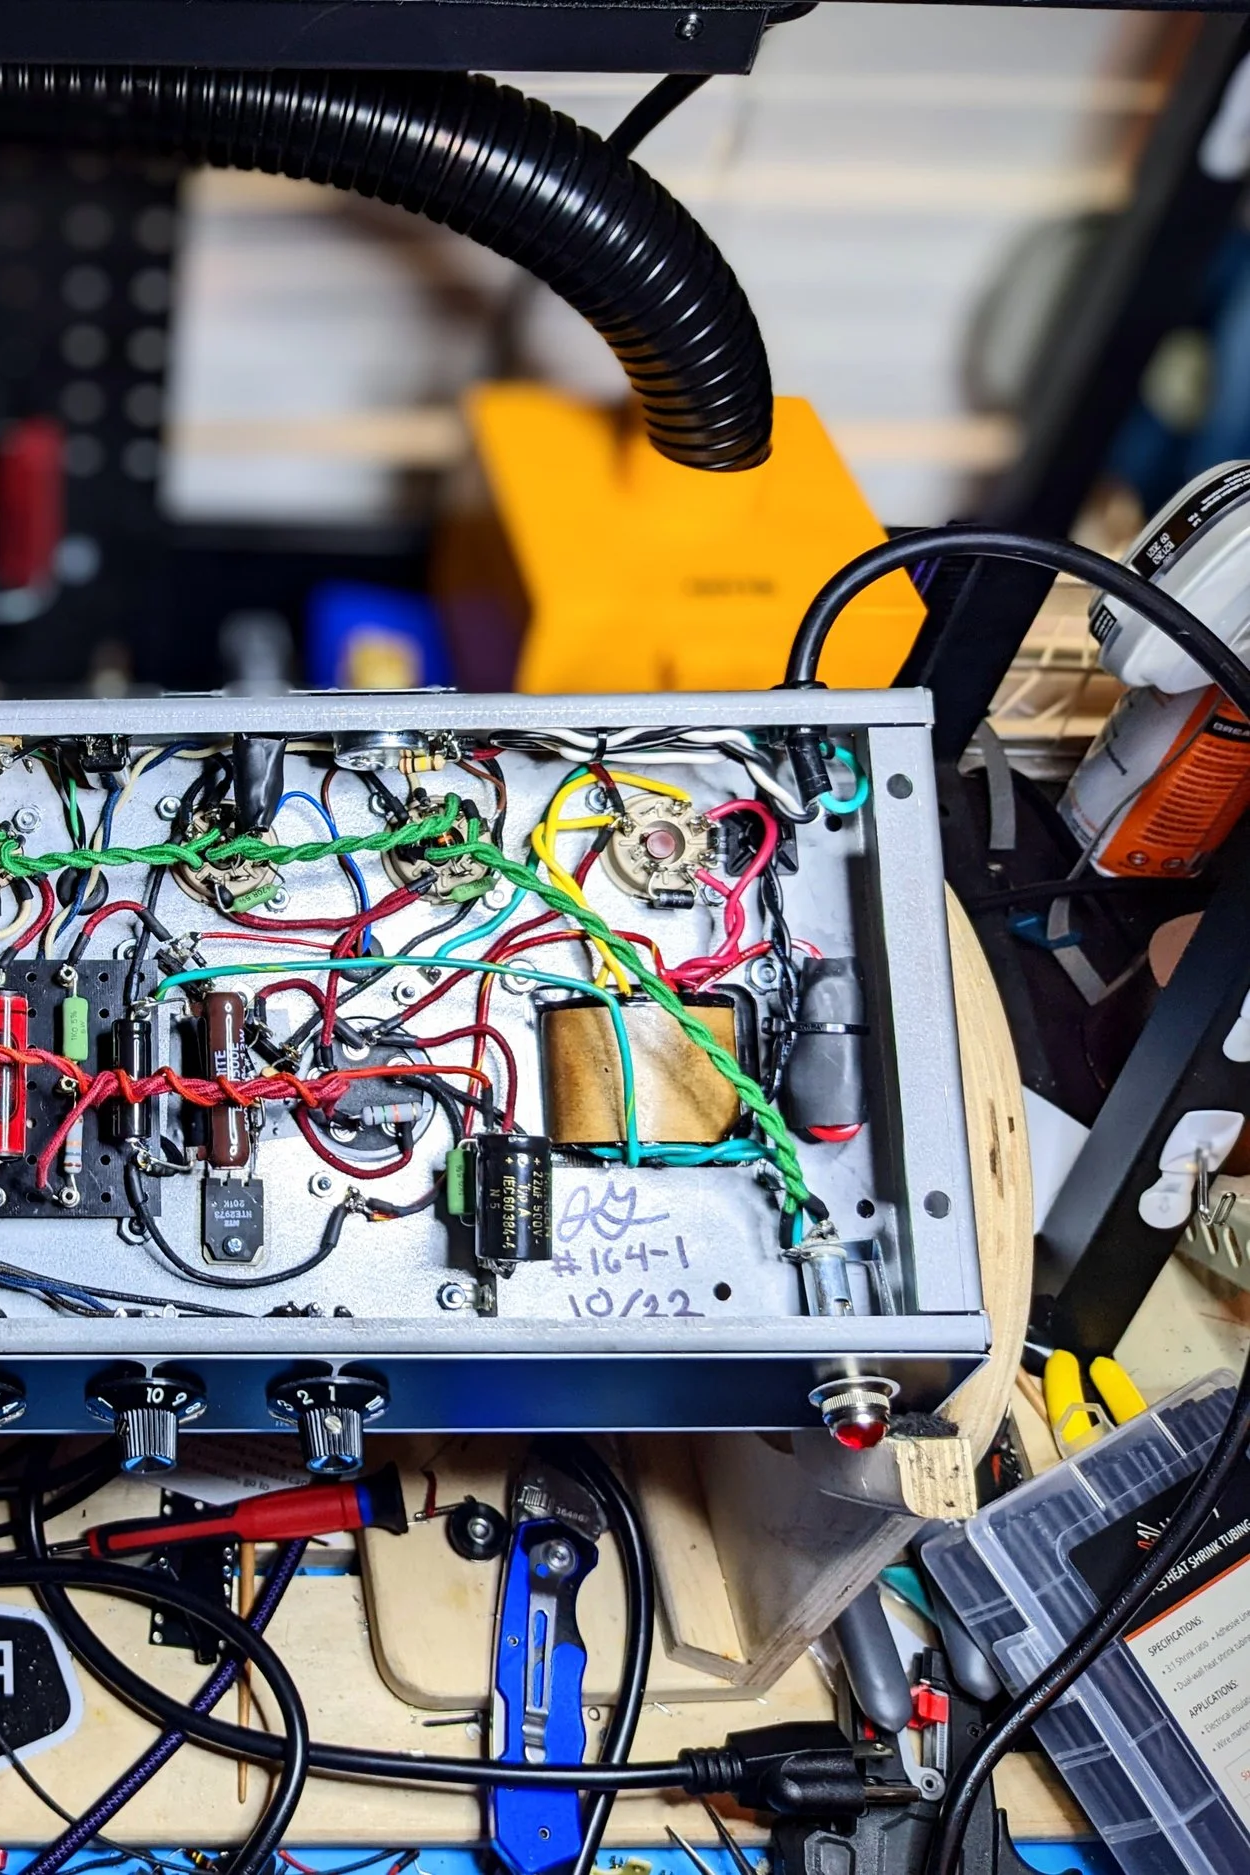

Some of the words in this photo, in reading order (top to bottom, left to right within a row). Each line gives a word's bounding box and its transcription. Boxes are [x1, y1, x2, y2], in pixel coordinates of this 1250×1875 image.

[213, 1210, 252, 1220] NTE2973
[533, 1204, 542, 1236] 500V
[550, 1235, 690, 1277] #164-1
[568, 1287, 706, 1317] 10/22
[146, 1387, 165, 1404] 10
[172, 1391, 188, 1407] 9
[185, 1401, 201, 1415] 8
[296, 1390, 314, 1405] 2
[328, 1386, 336, 1401] 1
[258, 1480, 270, 1491] to
[1165, 1560, 1190, 1584] HEAT
[1187, 1539, 1224, 1569] SHRINK
[1218, 1518, 1250, 1547] TUBING
[1147, 1615, 1205, 1657] SPECIFICATIONS:
[1188, 1679, 1239, 1719] APPLICATIONS:
